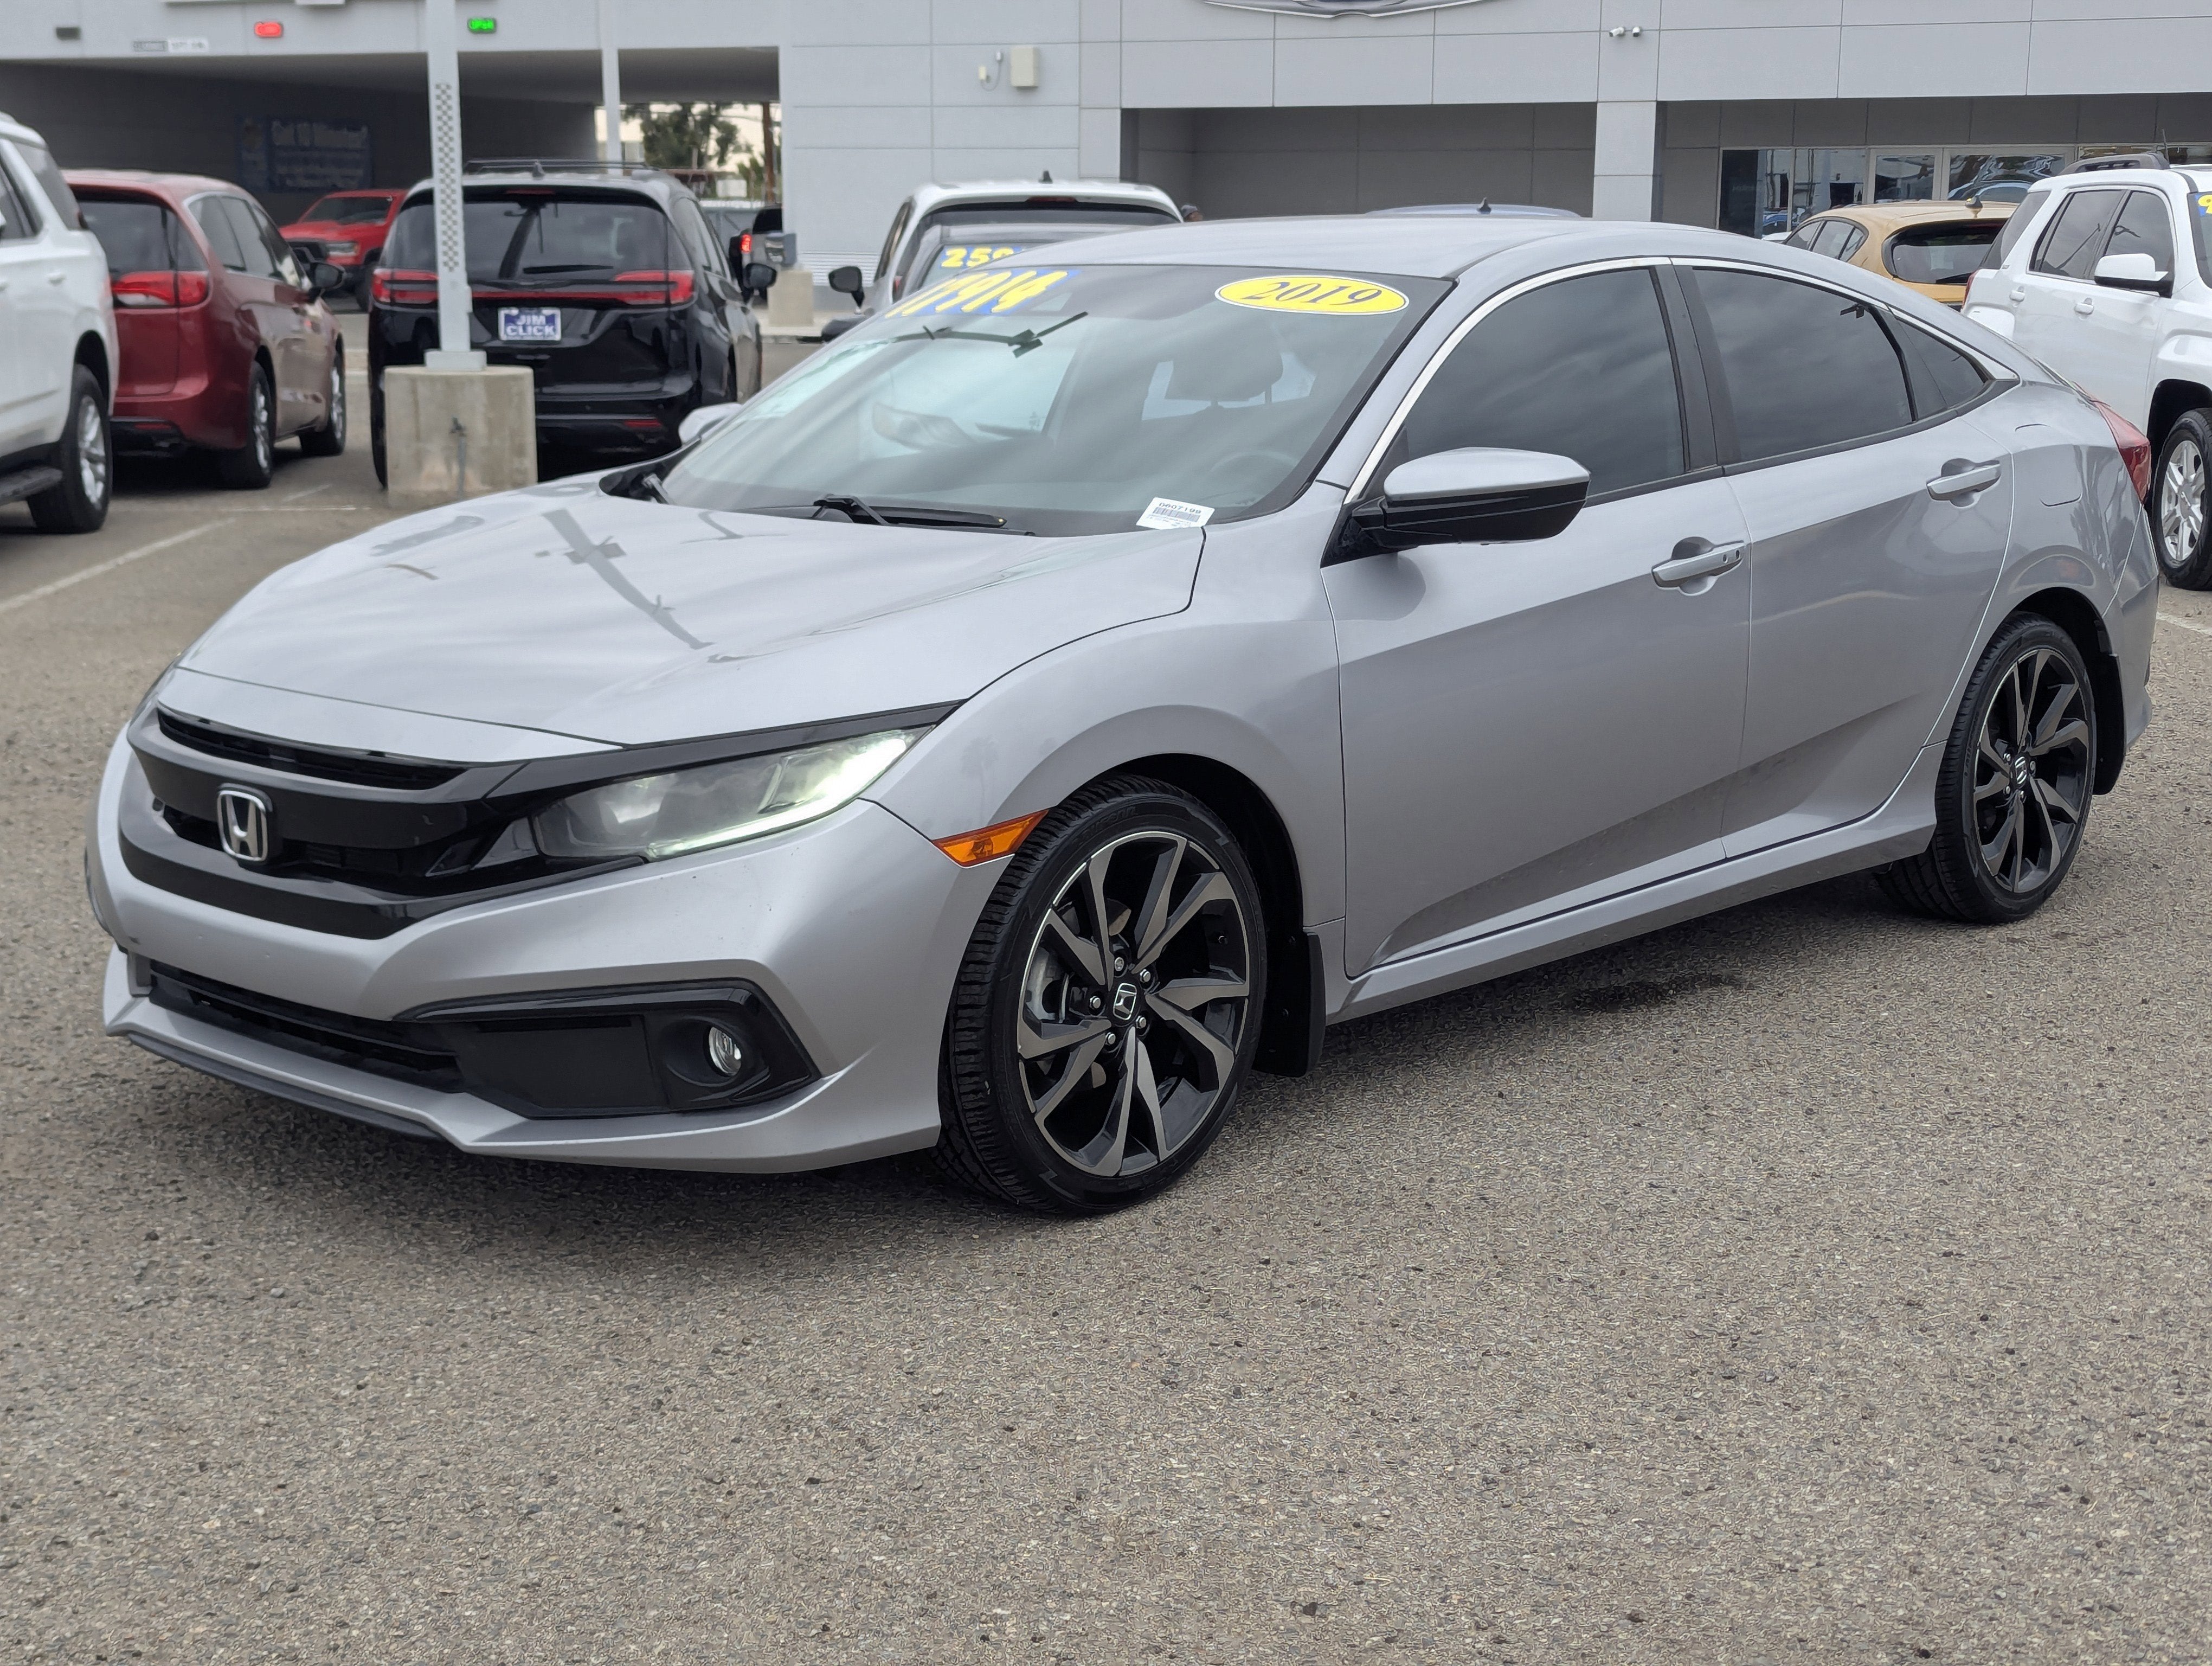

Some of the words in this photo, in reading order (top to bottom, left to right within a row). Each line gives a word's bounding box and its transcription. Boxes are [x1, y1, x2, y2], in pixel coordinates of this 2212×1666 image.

[1240, 281, 1382, 305] 2019
[516, 315, 546, 325] JIM
[506, 325, 555, 336] CLICK
